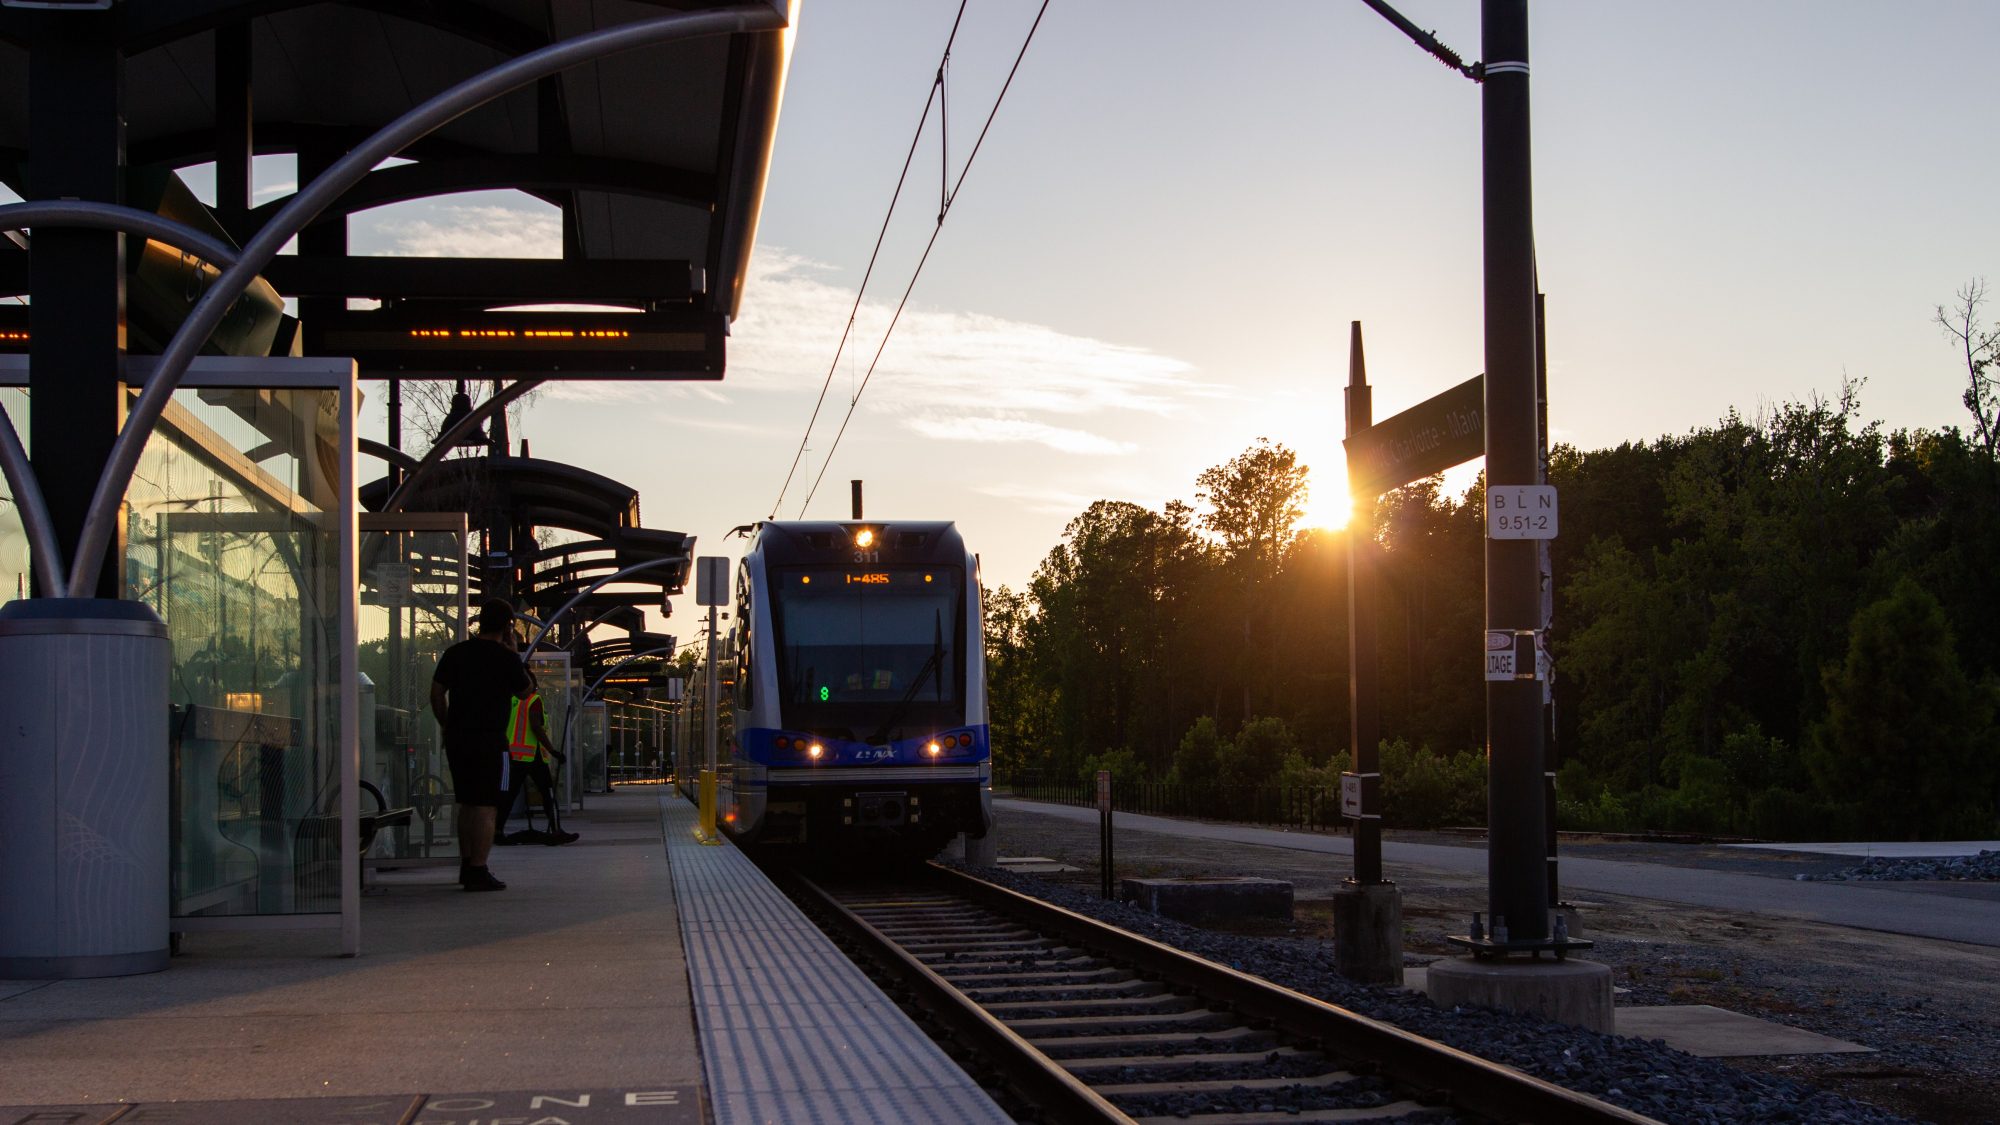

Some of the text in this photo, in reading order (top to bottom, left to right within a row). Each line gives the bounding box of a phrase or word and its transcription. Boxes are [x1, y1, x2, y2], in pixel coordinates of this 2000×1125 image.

[1389, 423, 1440, 463] Charlotte
[1446, 403, 1481, 440] Main
[1498, 515, 1548, 530] 9.51-2
[853, 550, 879, 563] 311
[846, 573, 890, 584] I-485
[820, 686, 829, 701] 8
